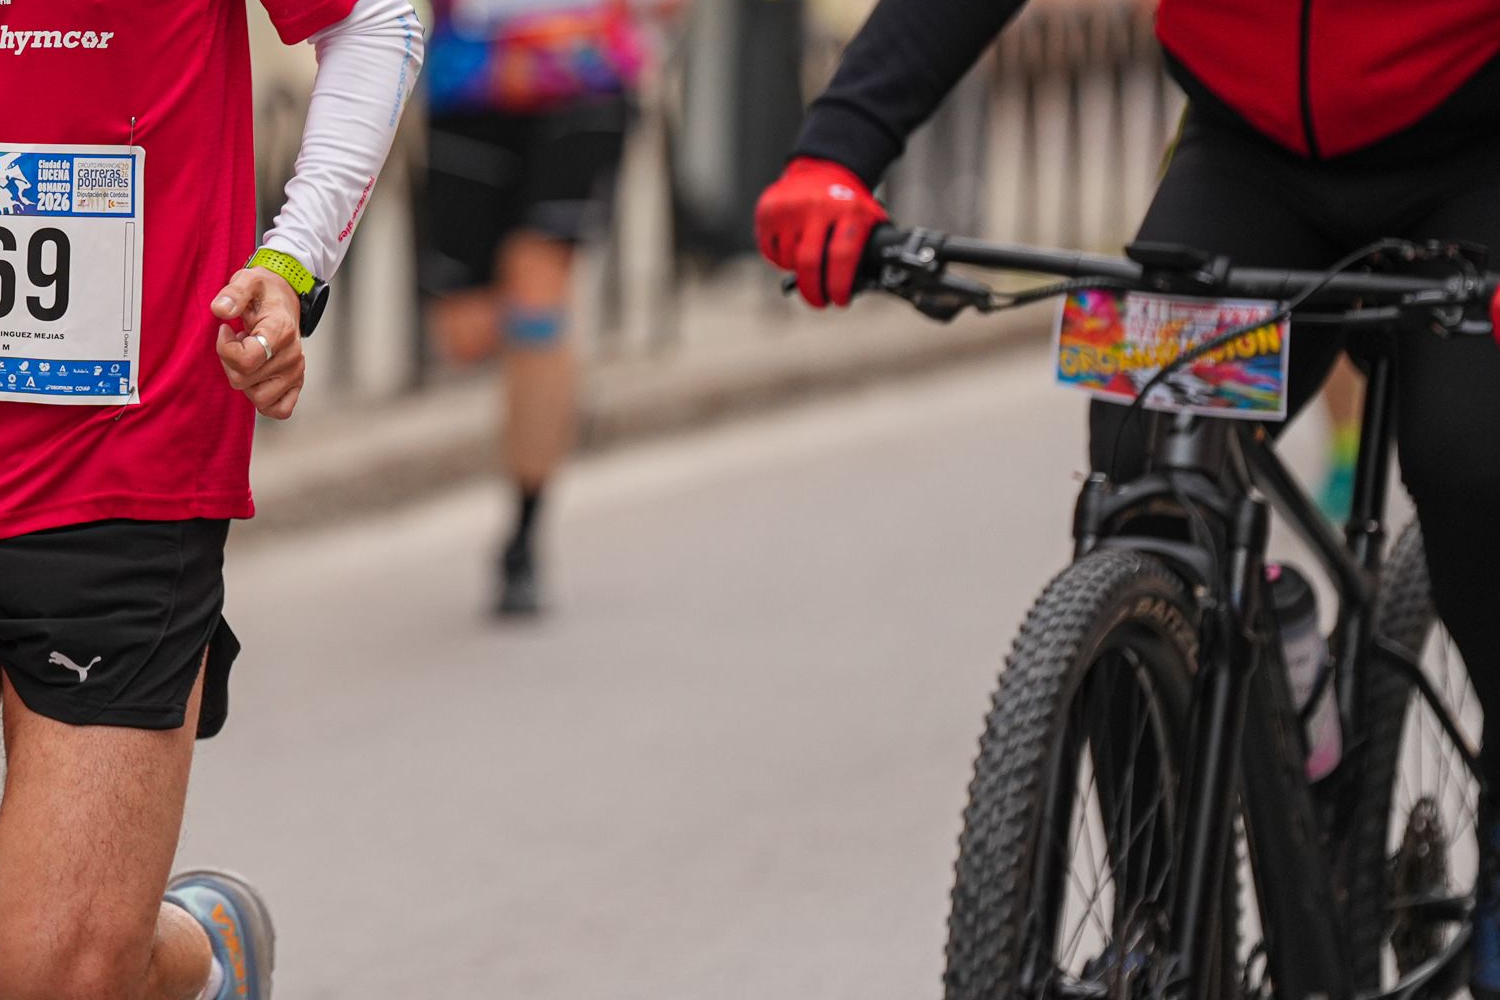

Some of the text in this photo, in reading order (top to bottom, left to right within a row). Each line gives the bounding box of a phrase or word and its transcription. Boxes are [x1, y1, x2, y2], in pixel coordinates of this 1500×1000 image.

[38, 160, 70, 169] Ciudad de
[38, 169, 69, 181] LUCENA
[78, 169, 120, 178] carreras
[78, 176, 129, 190] populares
[37, 192, 70, 211] 2026
[34, 332, 65, 340] MEJIAS
